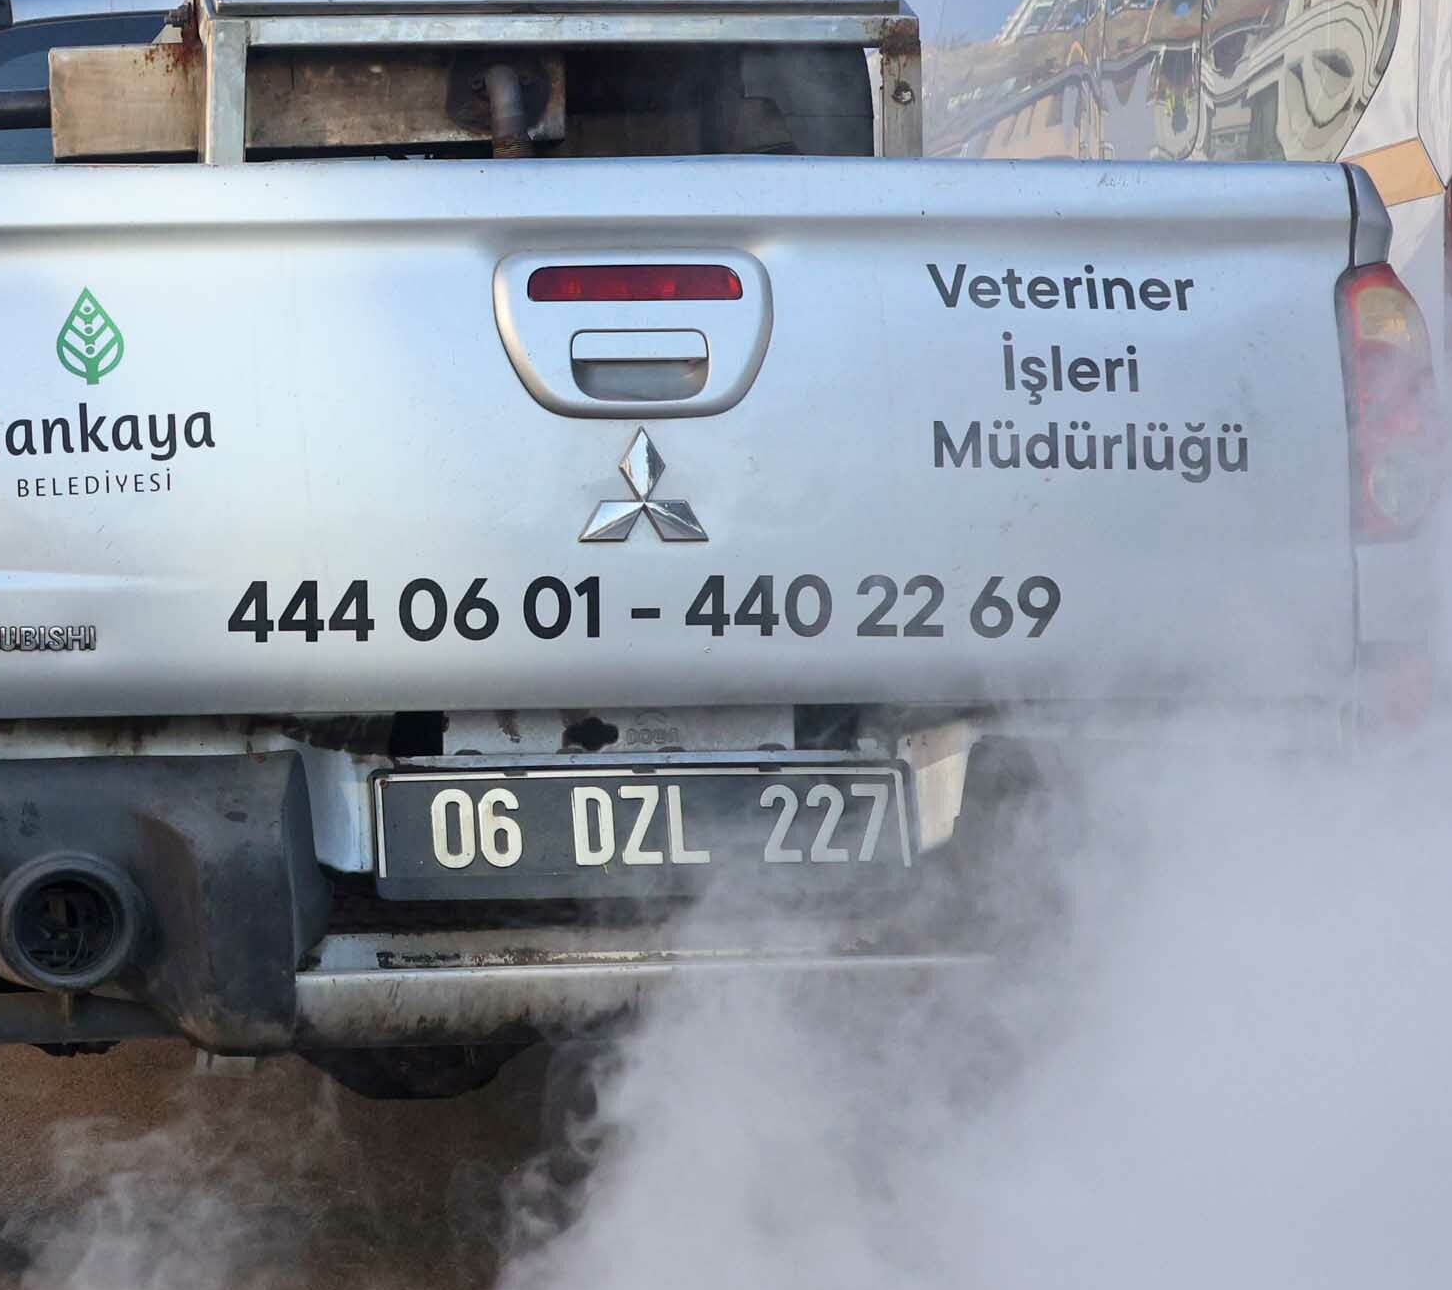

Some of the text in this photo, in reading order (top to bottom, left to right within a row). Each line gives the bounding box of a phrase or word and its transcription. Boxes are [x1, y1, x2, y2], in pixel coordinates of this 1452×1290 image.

[926, 264, 1194, 311] Veteriner
[1003, 332, 1138, 405] İşleri
[18, 468, 172, 498] BELEDİYESİ
[934, 420, 1248, 484] Müdürlüğü
[228, 580, 374, 642] 444
[399, 578, 499, 641] 06
[524, 576, 601, 639] 01
[685, 574, 832, 637] 440
[856, 575, 944, 638] 22
[970, 576, 1061, 638] 69
[431, 783, 890, 868] 06 DZL 227
